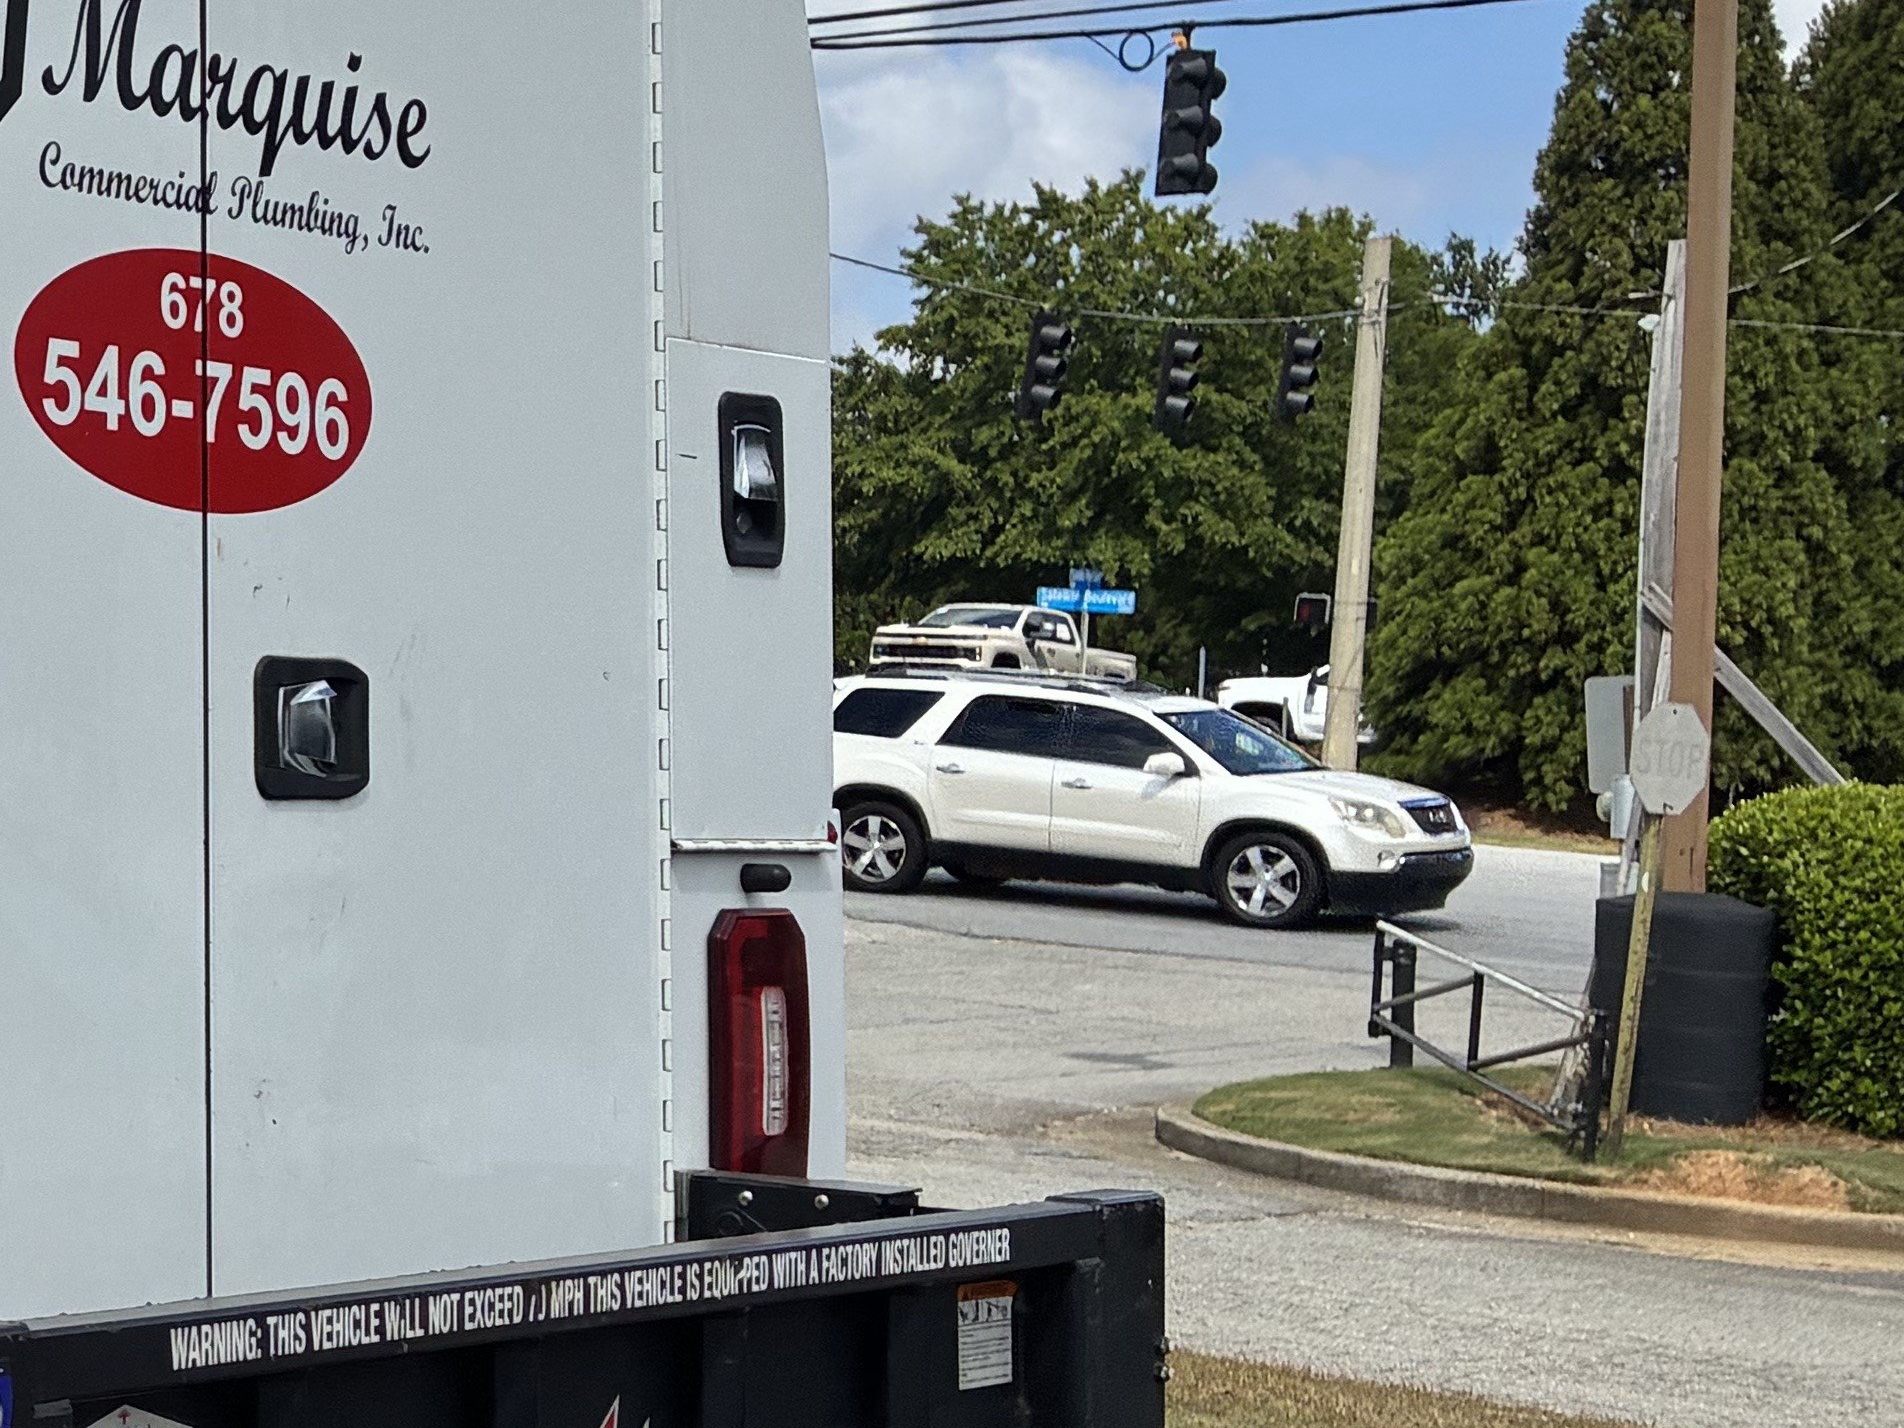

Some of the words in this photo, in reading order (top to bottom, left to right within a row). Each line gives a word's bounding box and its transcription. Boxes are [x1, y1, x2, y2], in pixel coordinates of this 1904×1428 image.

[39, 141, 218, 215] Commercial
[227, 175, 369, 255] Plumbing,
[378, 204, 431, 254] Inc.
[160, 272, 244, 339] 678
[41, 338, 349, 461] 546-7596
[1636, 738, 1703, 779] STOP
[170, 1317, 262, 1371] WARNING:
[267, 1311, 307, 1358] THIS
[310, 1302, 381, 1351] VEHICLE
[384, 1297, 425, 1342] WILL
[428, 1292, 461, 1335] NOT
[550, 1277, 584, 1319] MPH
[587, 1272, 622, 1314] THIS
[624, 1265, 683, 1309] VEHICLE
[686, 1263, 701, 1301] IS
[772, 1250, 807, 1289] WITH
[808, 1249, 819, 1285] A
[821, 1241, 880, 1283] FACTORY
[881, 1234, 945, 1276] INSTALLED
[948, 1227, 1011, 1269] GOVERNER
